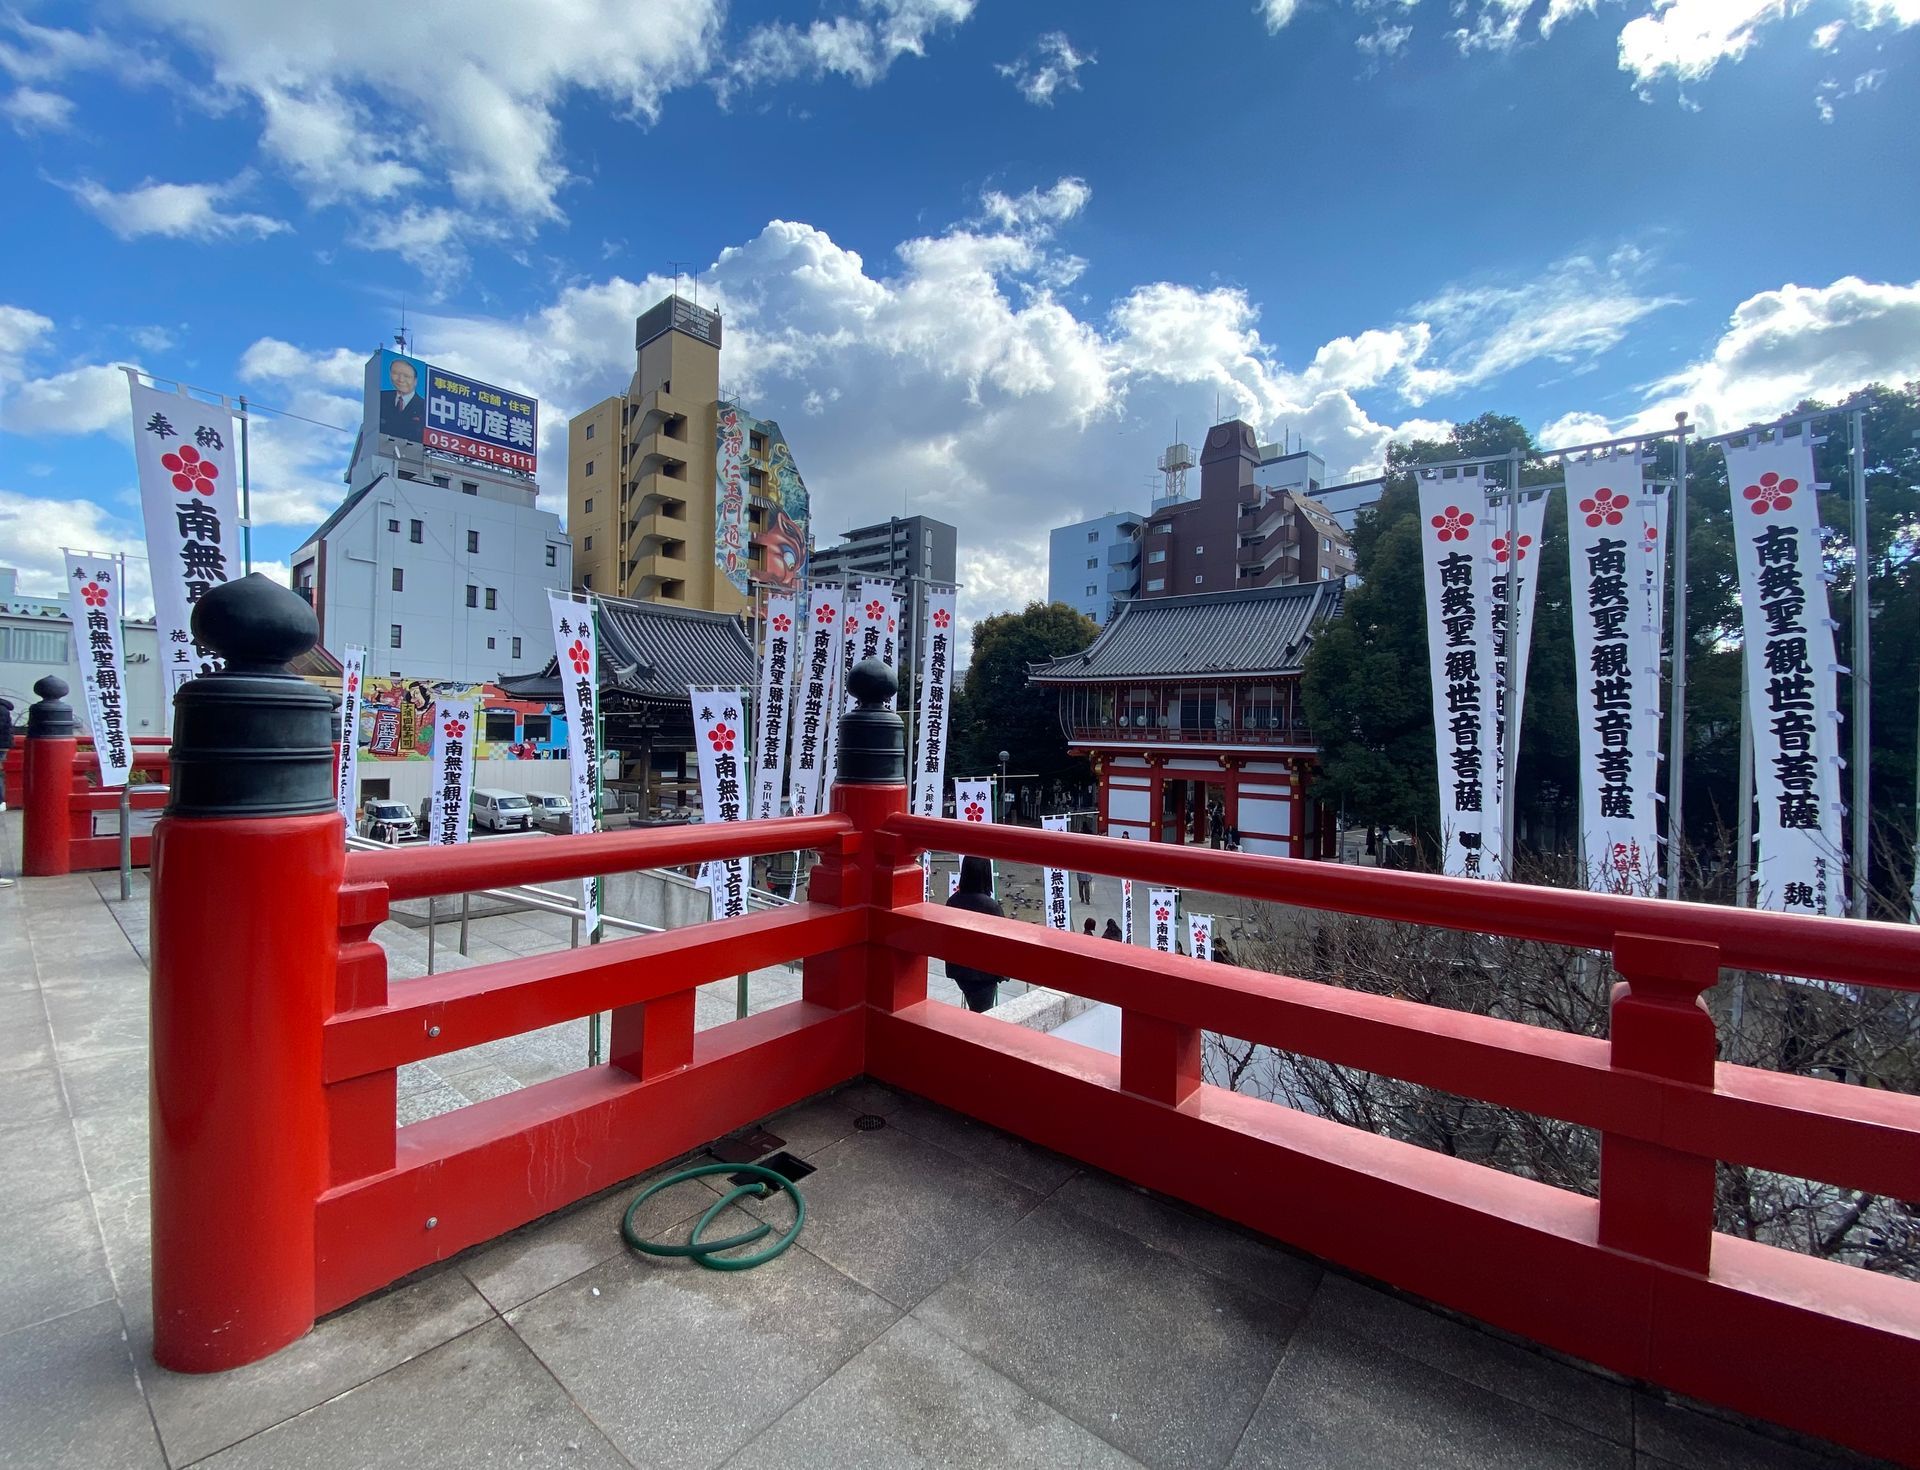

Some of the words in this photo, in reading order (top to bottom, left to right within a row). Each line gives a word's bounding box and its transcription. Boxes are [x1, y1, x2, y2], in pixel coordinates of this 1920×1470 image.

[434, 377, 531, 416] 事務所・店舗・住宅
[145, 411, 224, 451] 奉納
[430, 395, 533, 448] 中駒産業
[429, 433, 532, 470] 052-451-8111
[72, 567, 111, 583] 奉納
[170, 629, 190, 663] 施主
[559, 617, 590, 638] 奉納
[87, 609, 127, 768] 南無聖観世音菩薩
[1438, 551, 1483, 812] 南無聖観世音菩薩
[1584, 538, 1634, 819] 南無聖観世音菩薩
[1751, 525, 1822, 831] 南無聖観世音菩薩
[374, 712, 396, 753] 三陸屋
[440, 709, 470, 721] 奉納
[700, 706, 738, 722] 奉納
[960, 791, 986, 802] 奉納
[1784, 882, 1815, 908] 魏
